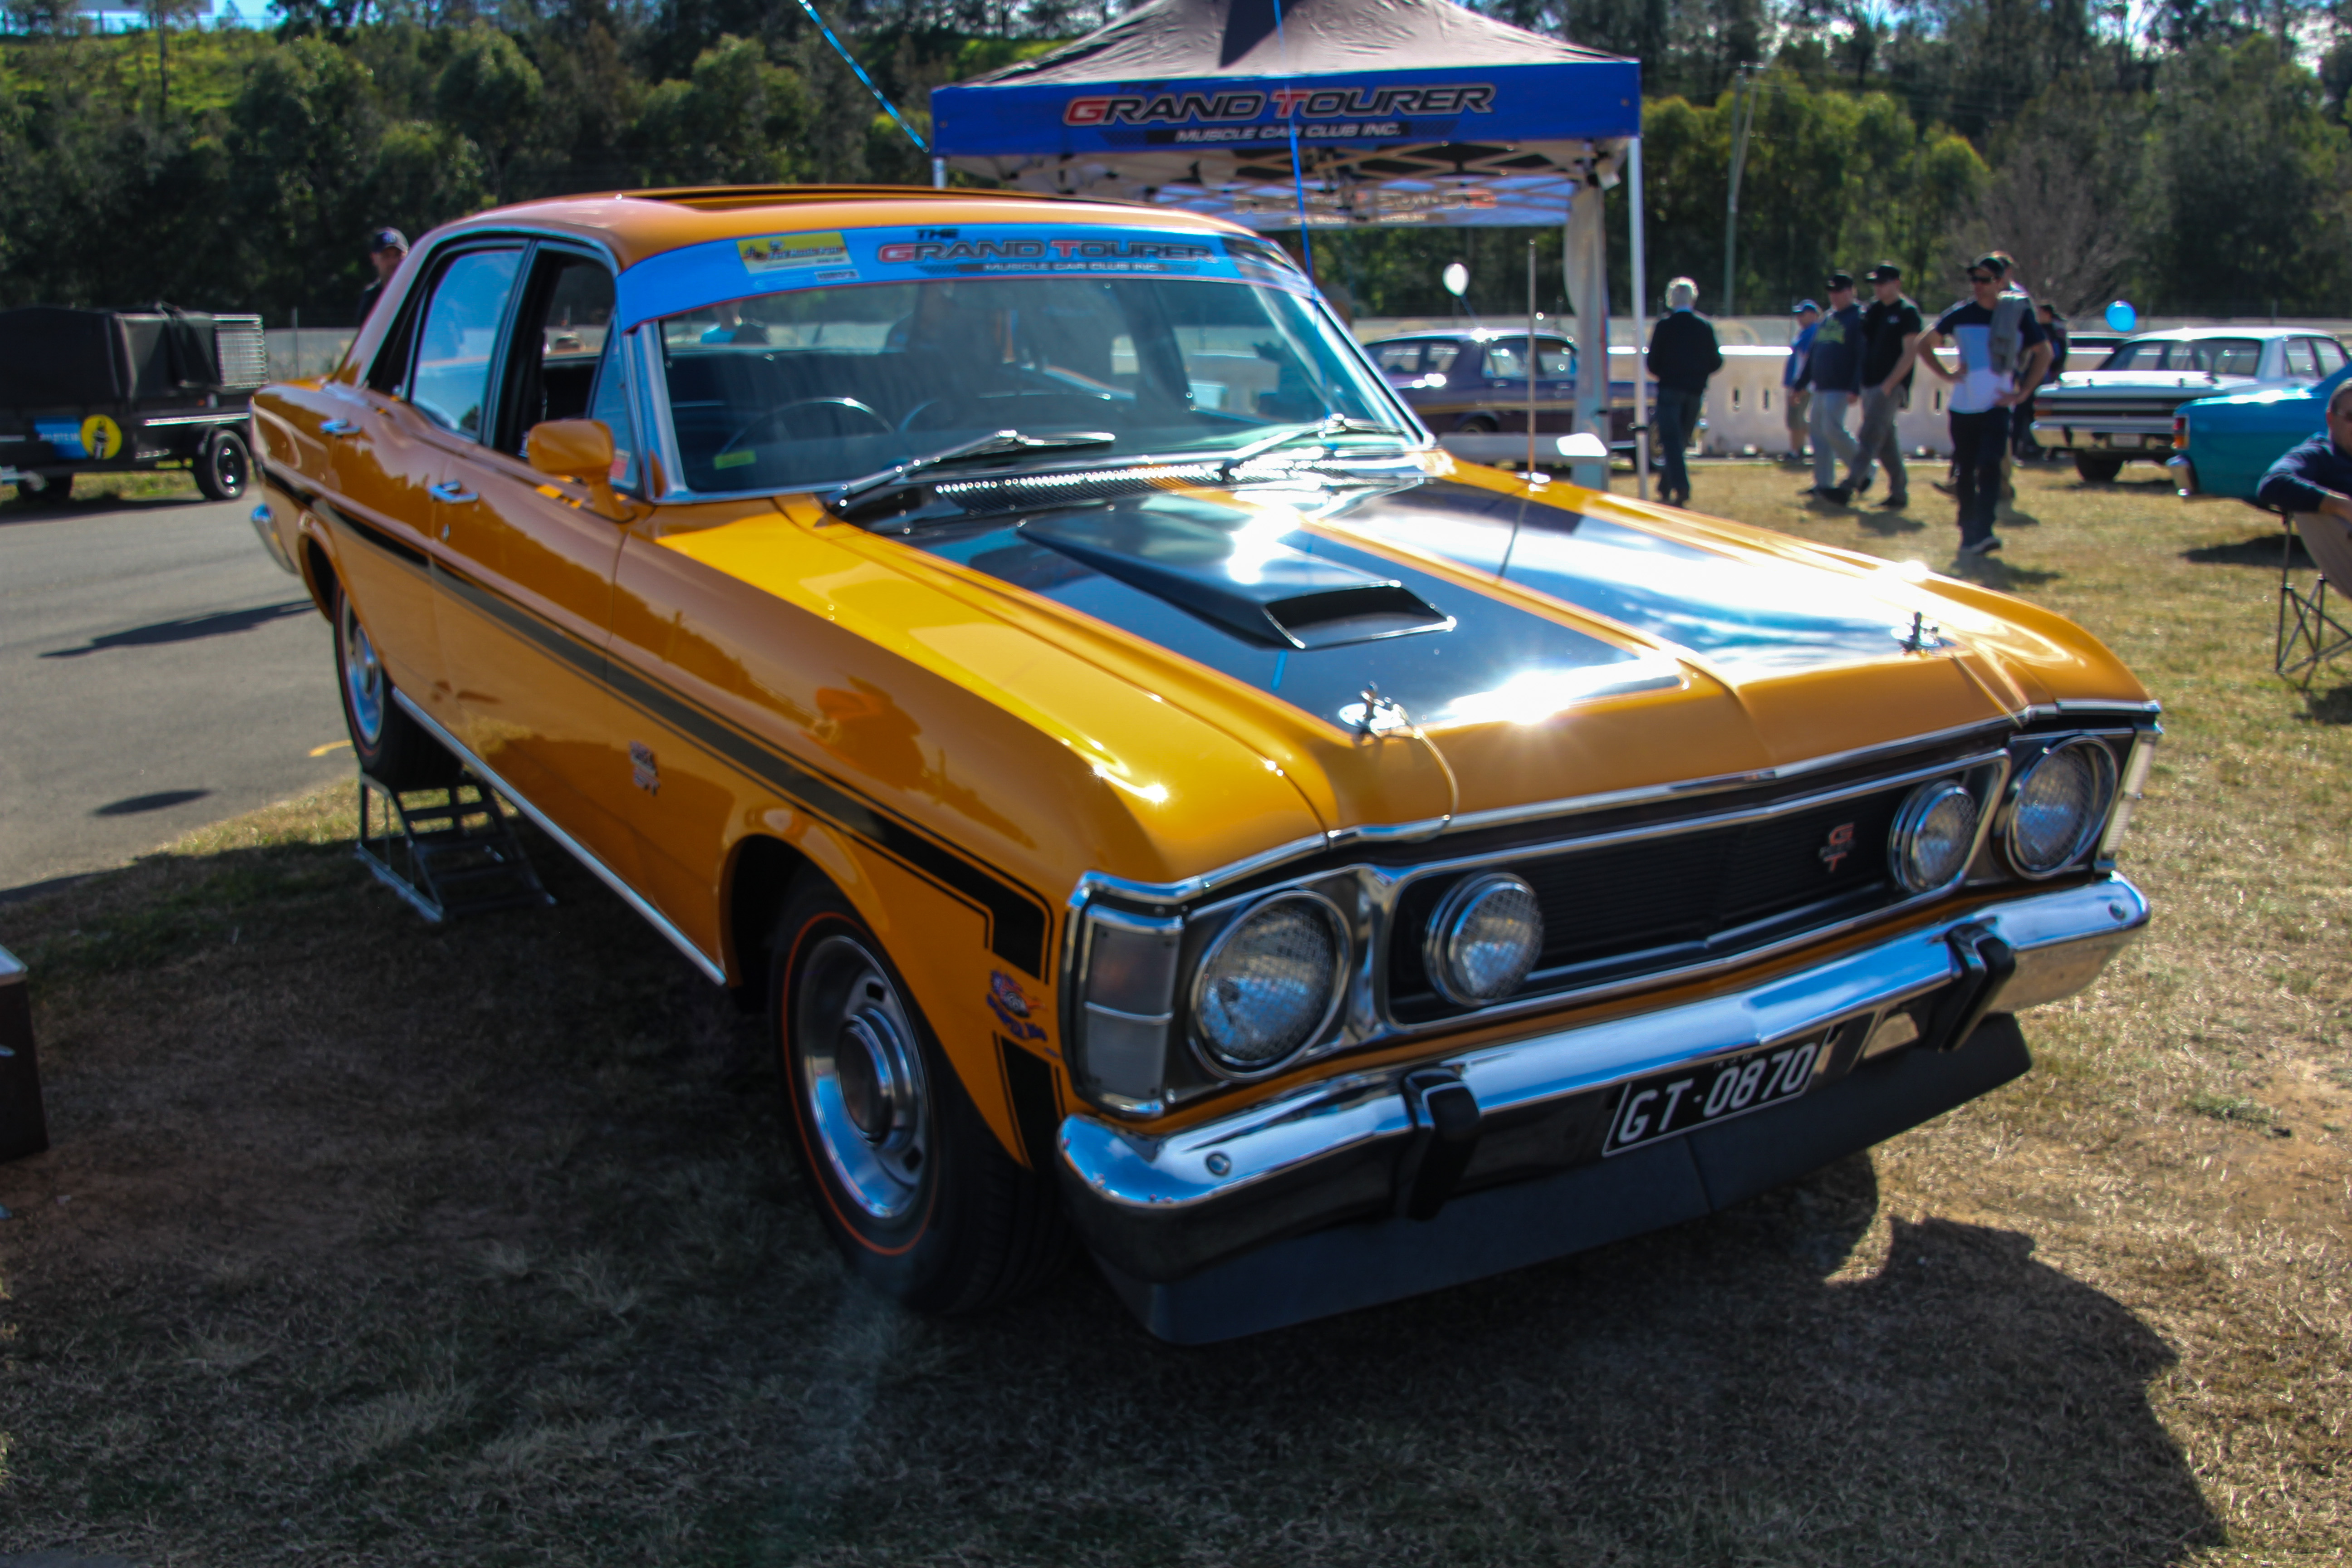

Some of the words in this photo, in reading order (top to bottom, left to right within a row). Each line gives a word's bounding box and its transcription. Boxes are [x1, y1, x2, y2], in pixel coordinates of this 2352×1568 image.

[1063, 90, 1266, 126] GRAND
[1270, 83, 1496, 119] TOURER
[1175, 127, 1256, 143] MUSCLE
[1304, 124, 1359, 138] CLUB
[1361, 122, 1401, 136] INC.
[916, 229, 960, 240] THE
[878, 240, 1045, 263] GRAND
[1050, 240, 1219, 263] TOURER
[983, 262, 1049, 271] MUSCLE
[1053, 262, 1087, 270] CAR
[1089, 261, 1130, 270] CLUB
